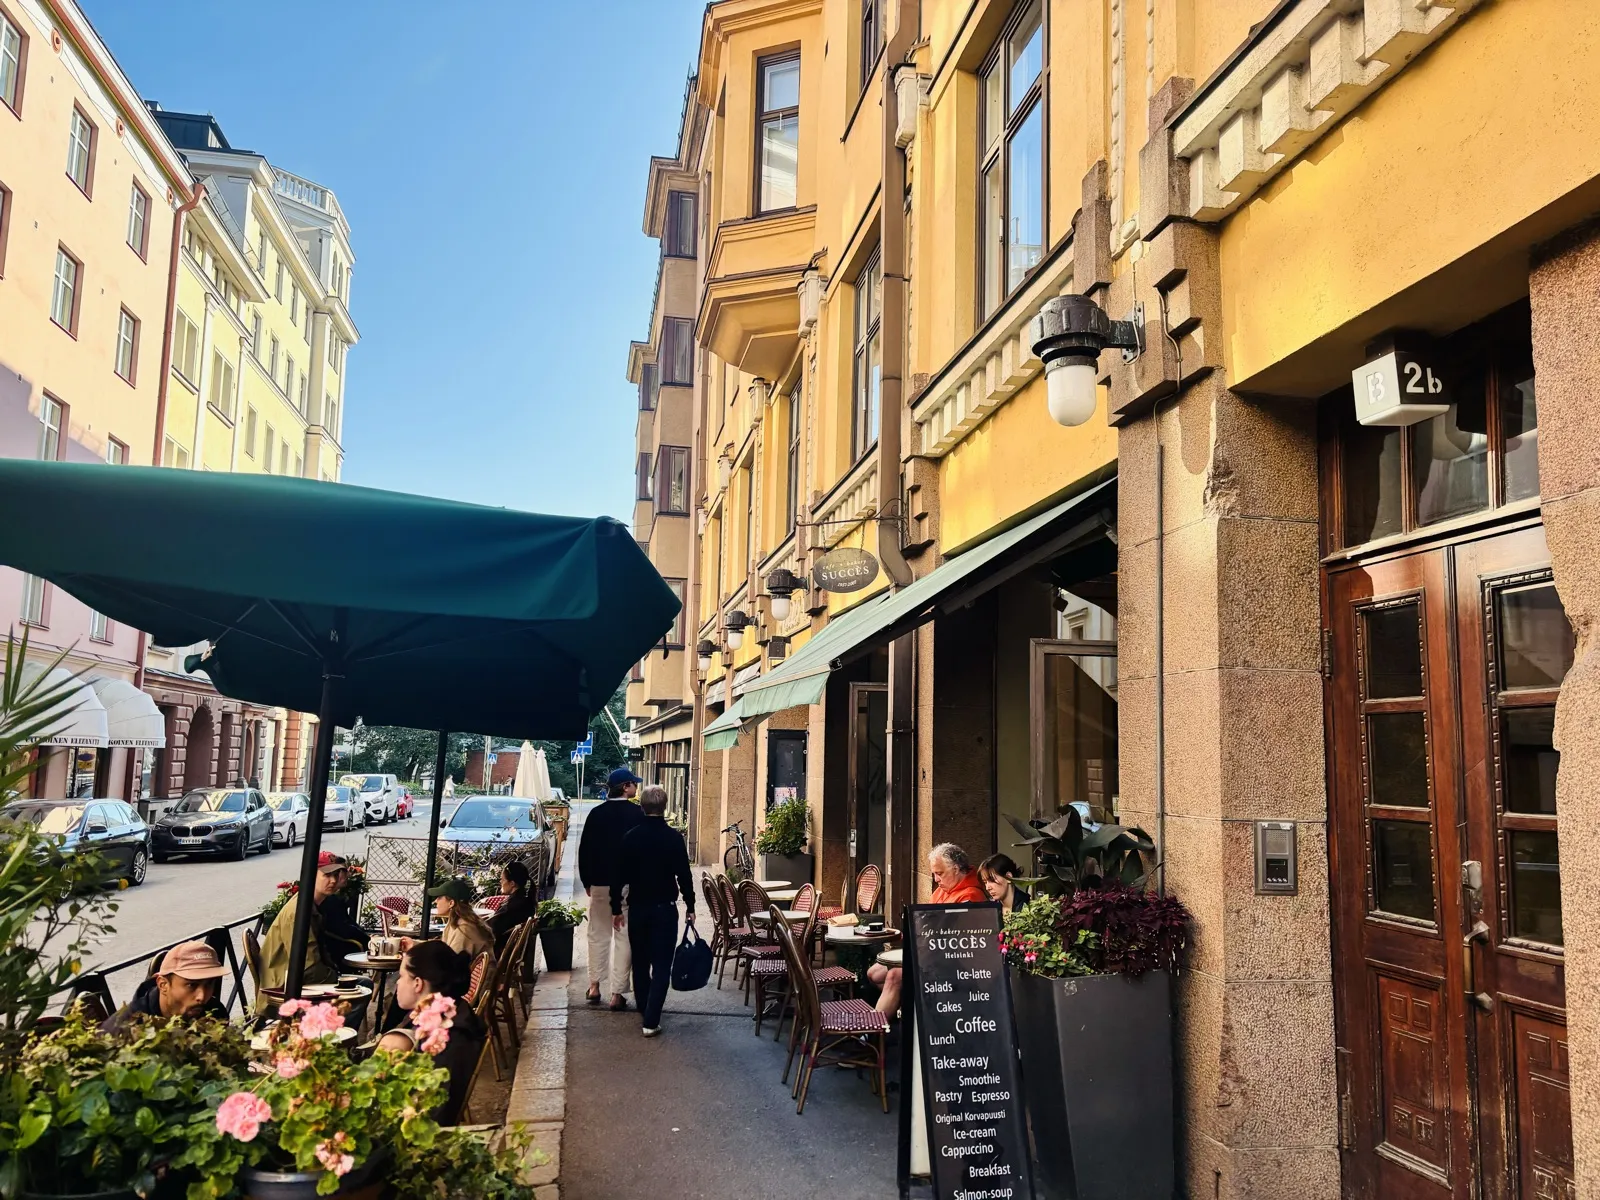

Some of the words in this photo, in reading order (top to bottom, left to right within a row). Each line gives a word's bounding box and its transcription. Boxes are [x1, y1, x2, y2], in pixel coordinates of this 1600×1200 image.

[1403, 361, 1443, 394] 2b
[1365, 371, 1386, 406] B
[821, 565, 869, 580] SUCCÈS
[940, 928, 961, 936] bakery
[928, 935, 987, 951] SUCCÈS
[944, 951, 974, 959] Helsinki
[956, 968, 992, 980] Ice-latte
[924, 981, 953, 993] Salads
[968, 990, 990, 1002] Juice
[936, 1001, 963, 1013] Cakes
[955, 1016, 997, 1034] Coffee
[929, 1033, 956, 1046] Lunch
[931, 1055, 989, 1070] Take-away
[958, 1073, 1001, 1087] Smoothie
[935, 1091, 963, 1104] Pastry
[971, 1091, 1011, 1105] Espresso
[935, 1112, 963, 1125] Original
[964, 1109, 1006, 1122] Korvapuusti
[953, 1128, 997, 1140] Ice-cream
[941, 1142, 994, 1159] Cappuccino
[968, 1163, 1012, 1178] Breakfast
[953, 1187, 1013, 1200] Salmon-soup
